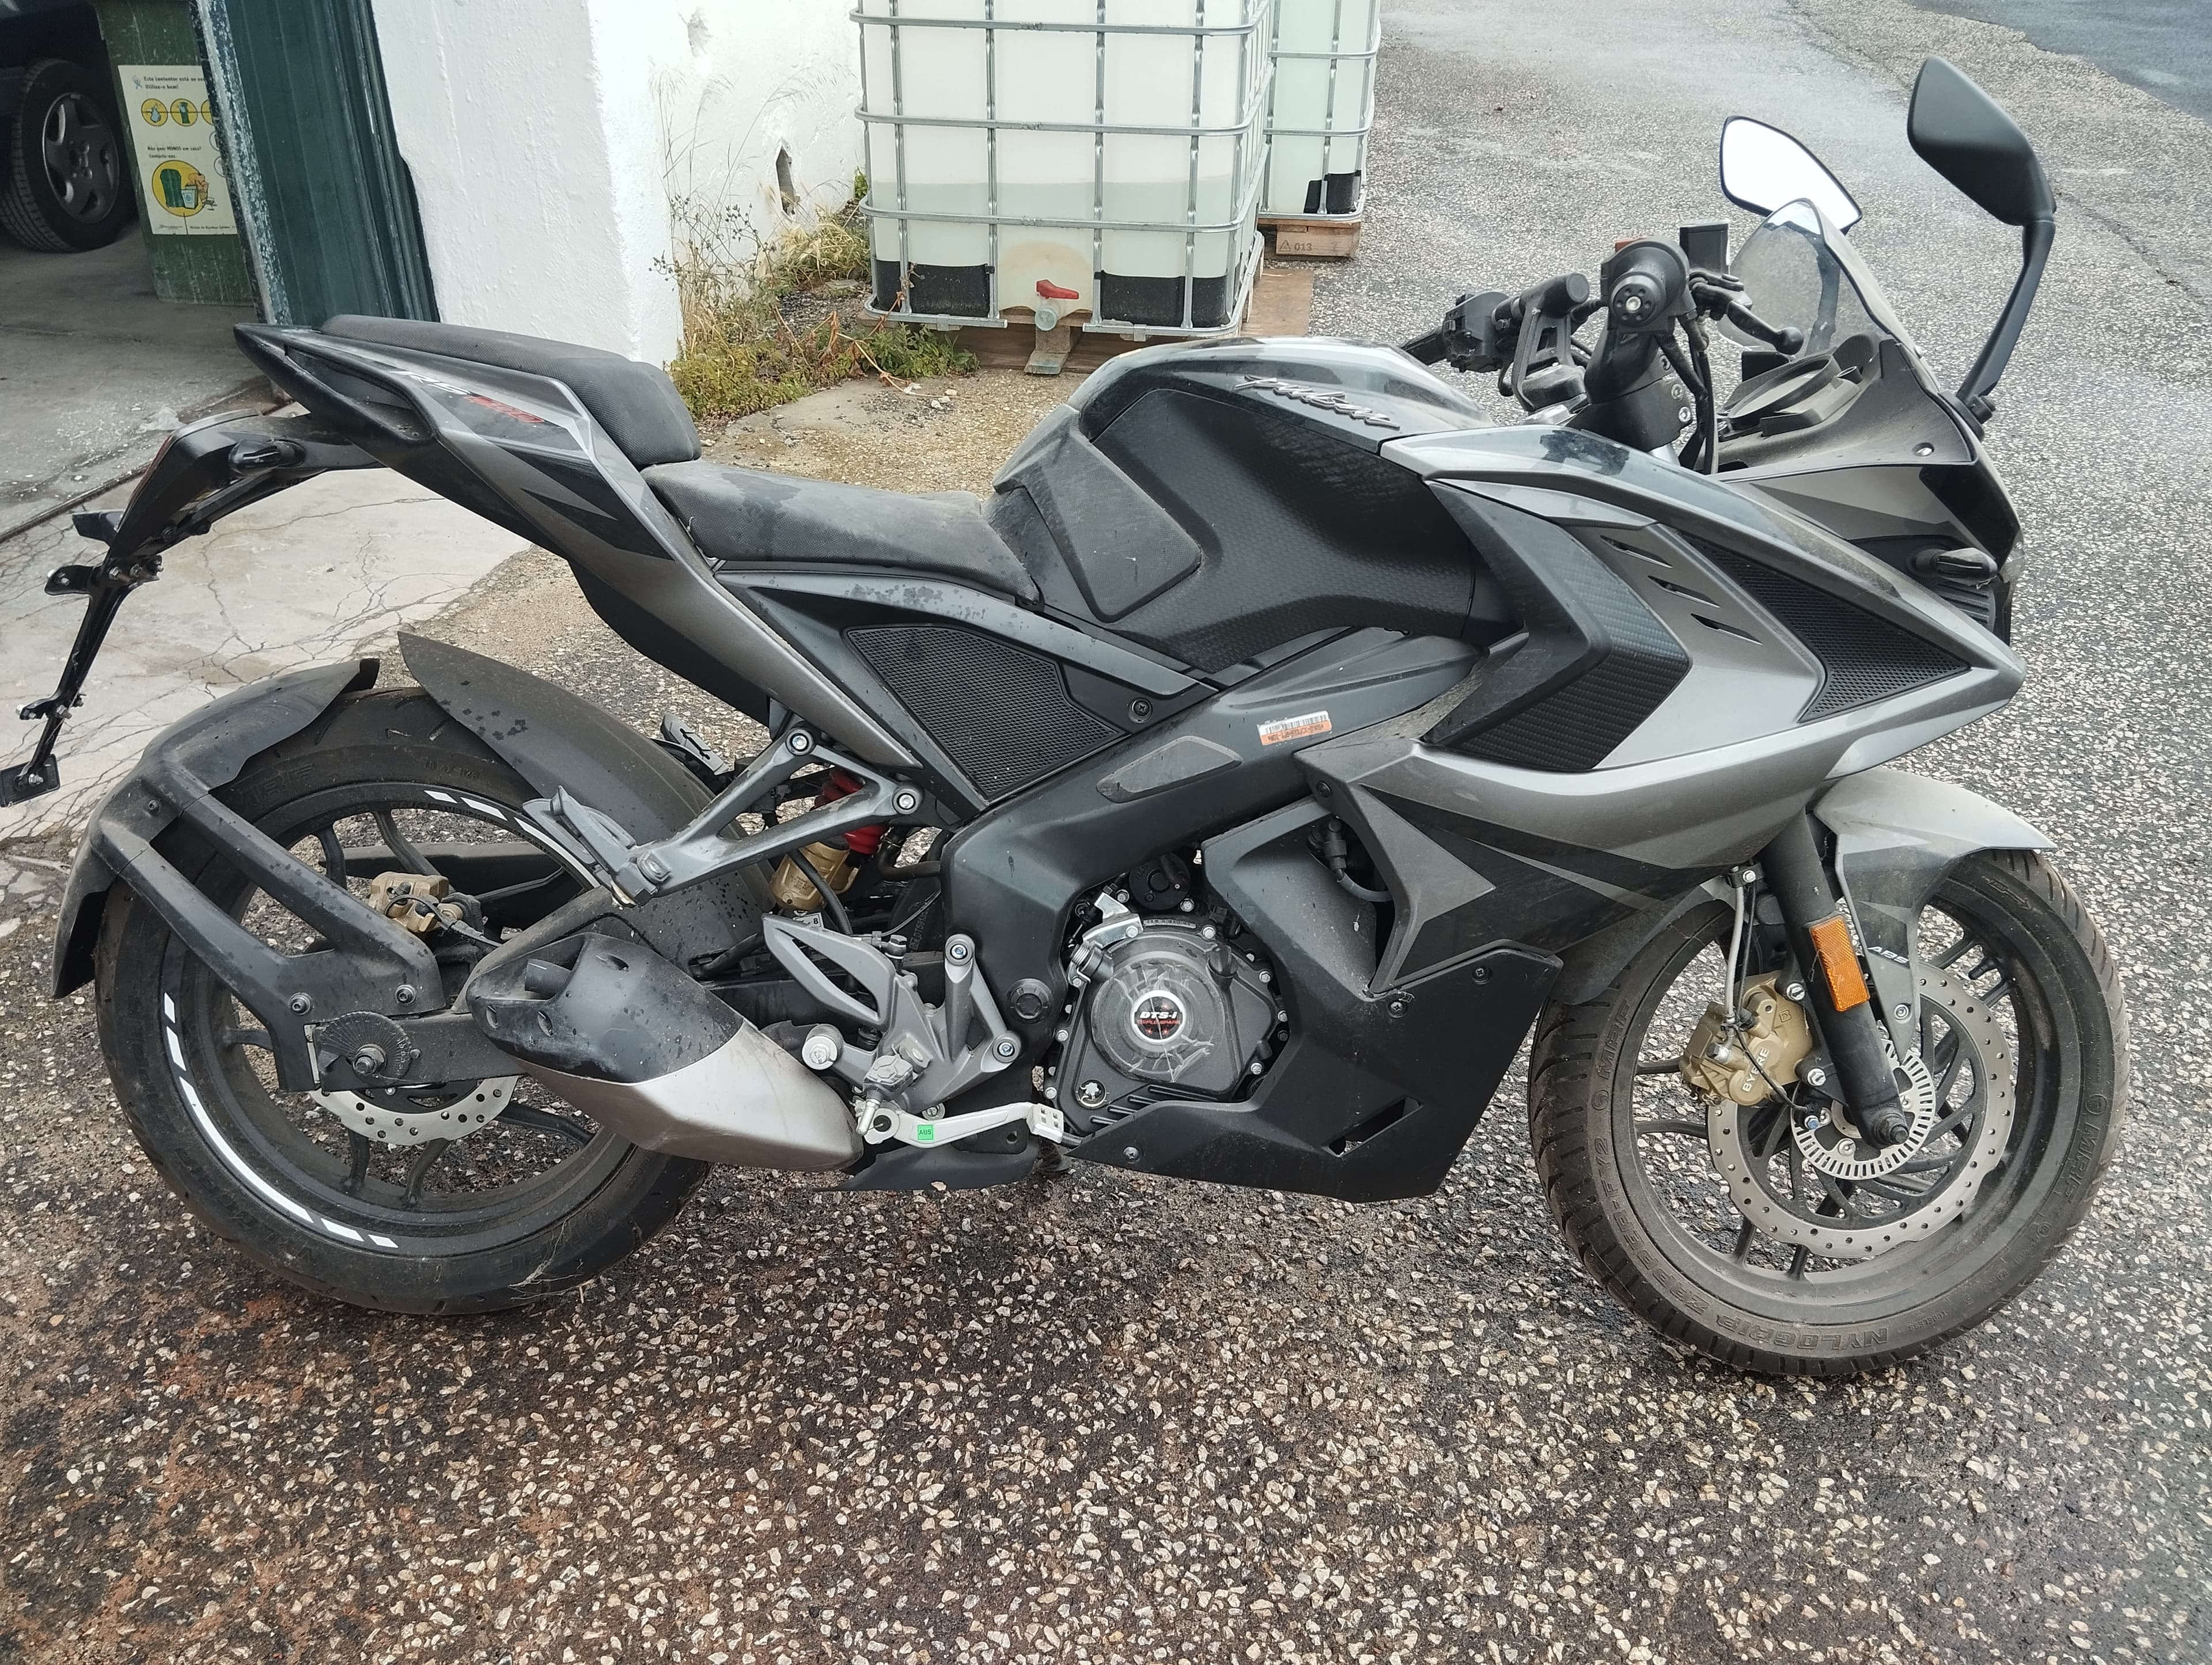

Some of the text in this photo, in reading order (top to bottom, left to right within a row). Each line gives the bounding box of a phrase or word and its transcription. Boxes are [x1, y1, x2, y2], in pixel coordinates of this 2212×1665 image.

[1294, 243, 1312, 251] 013
[1867, 946, 1909, 964] ABS
[1597, 999, 1631, 1080] MRF
[1907, 1310, 1947, 1331] TUBELESS
[1716, 1314, 1888, 1351] NYLOGRIP
